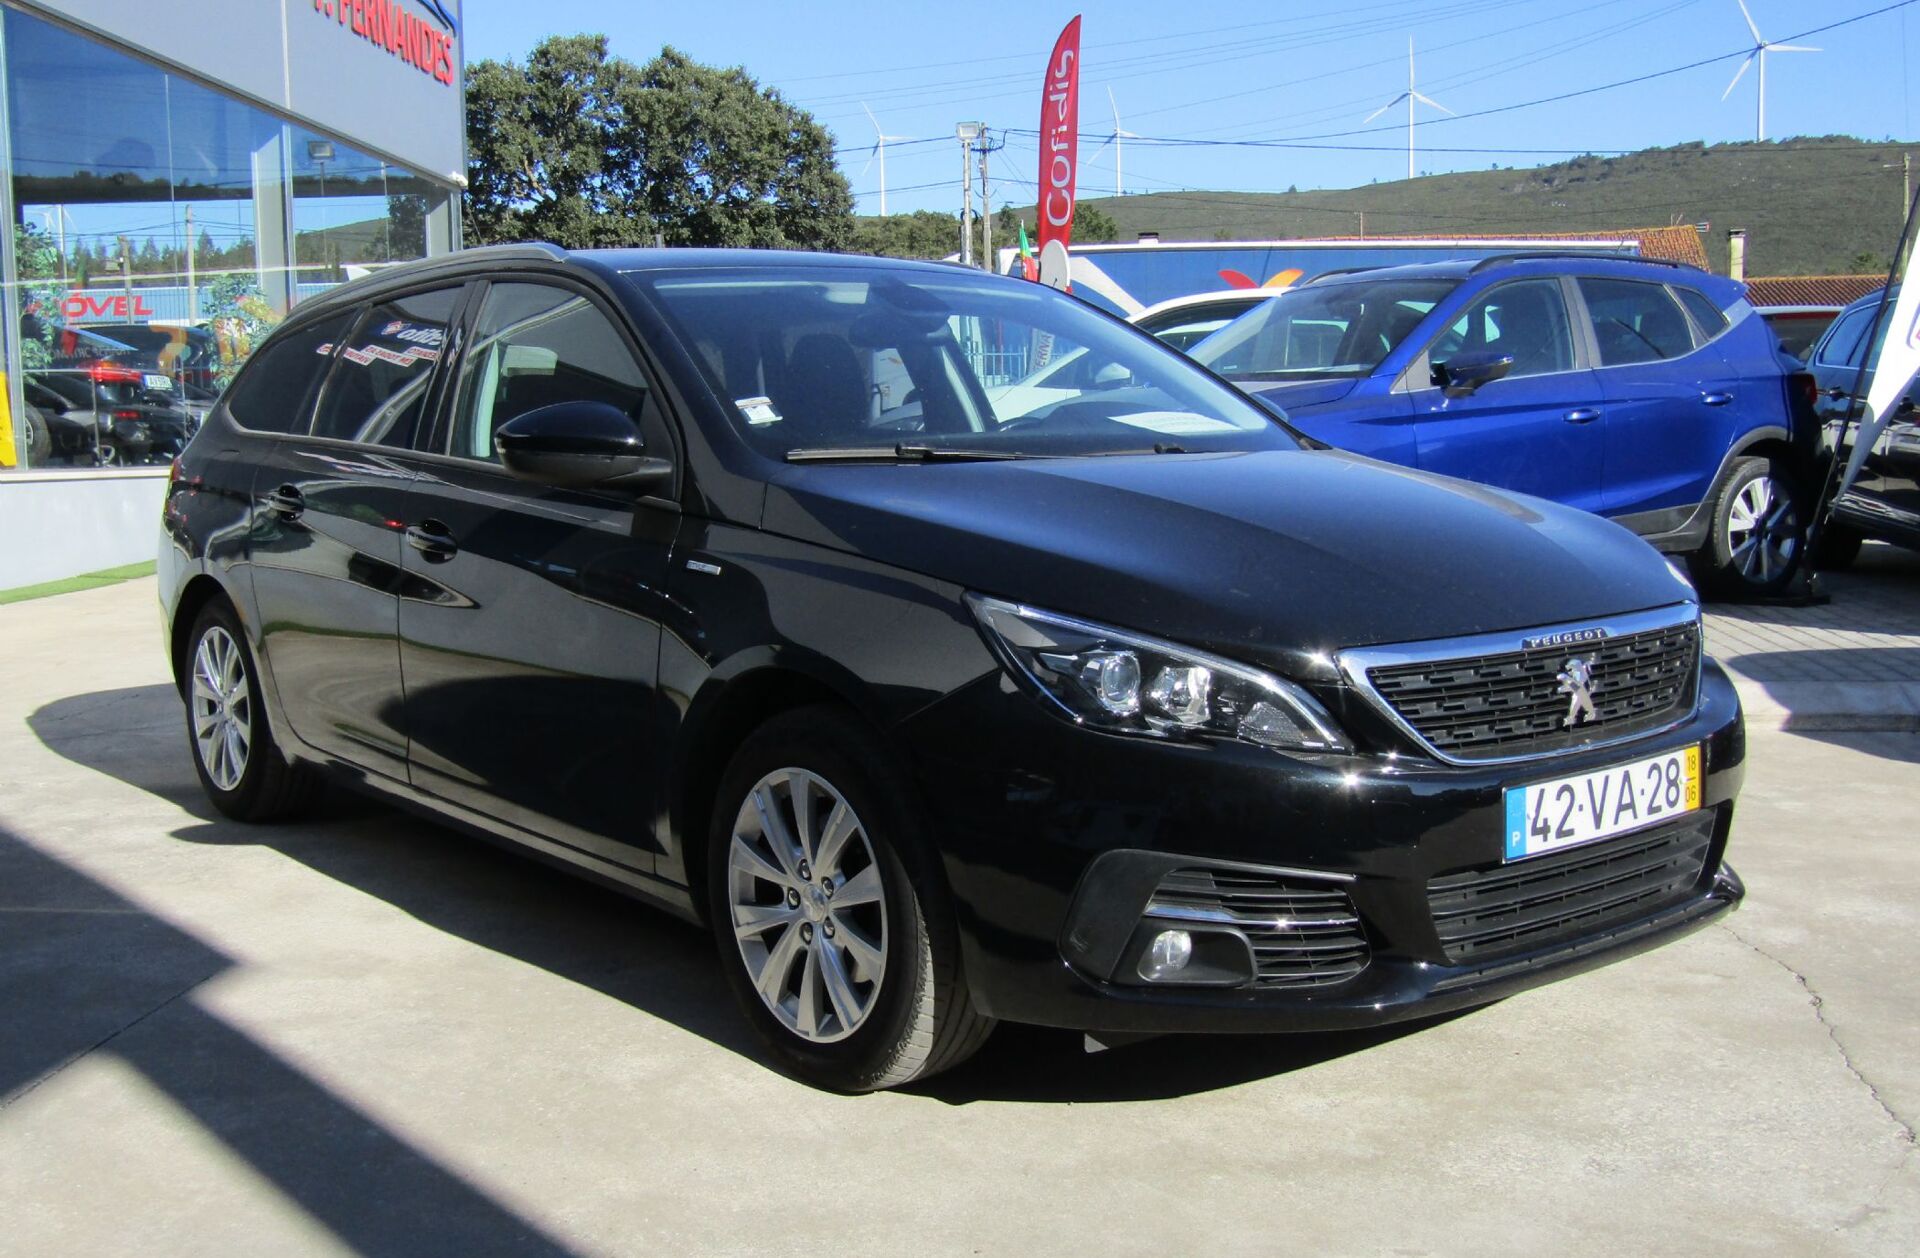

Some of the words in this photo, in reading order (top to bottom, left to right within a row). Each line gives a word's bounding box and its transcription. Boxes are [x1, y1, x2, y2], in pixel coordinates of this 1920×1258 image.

[1046, 49, 1074, 227] Cofidis
[56, 290, 153, 318] ÓVEL
[1530, 628, 1603, 648] PEUGEOT
[1687, 754, 1697, 771] 18
[1685, 785, 1697, 803] 06
[1511, 831, 1521, 848] P
